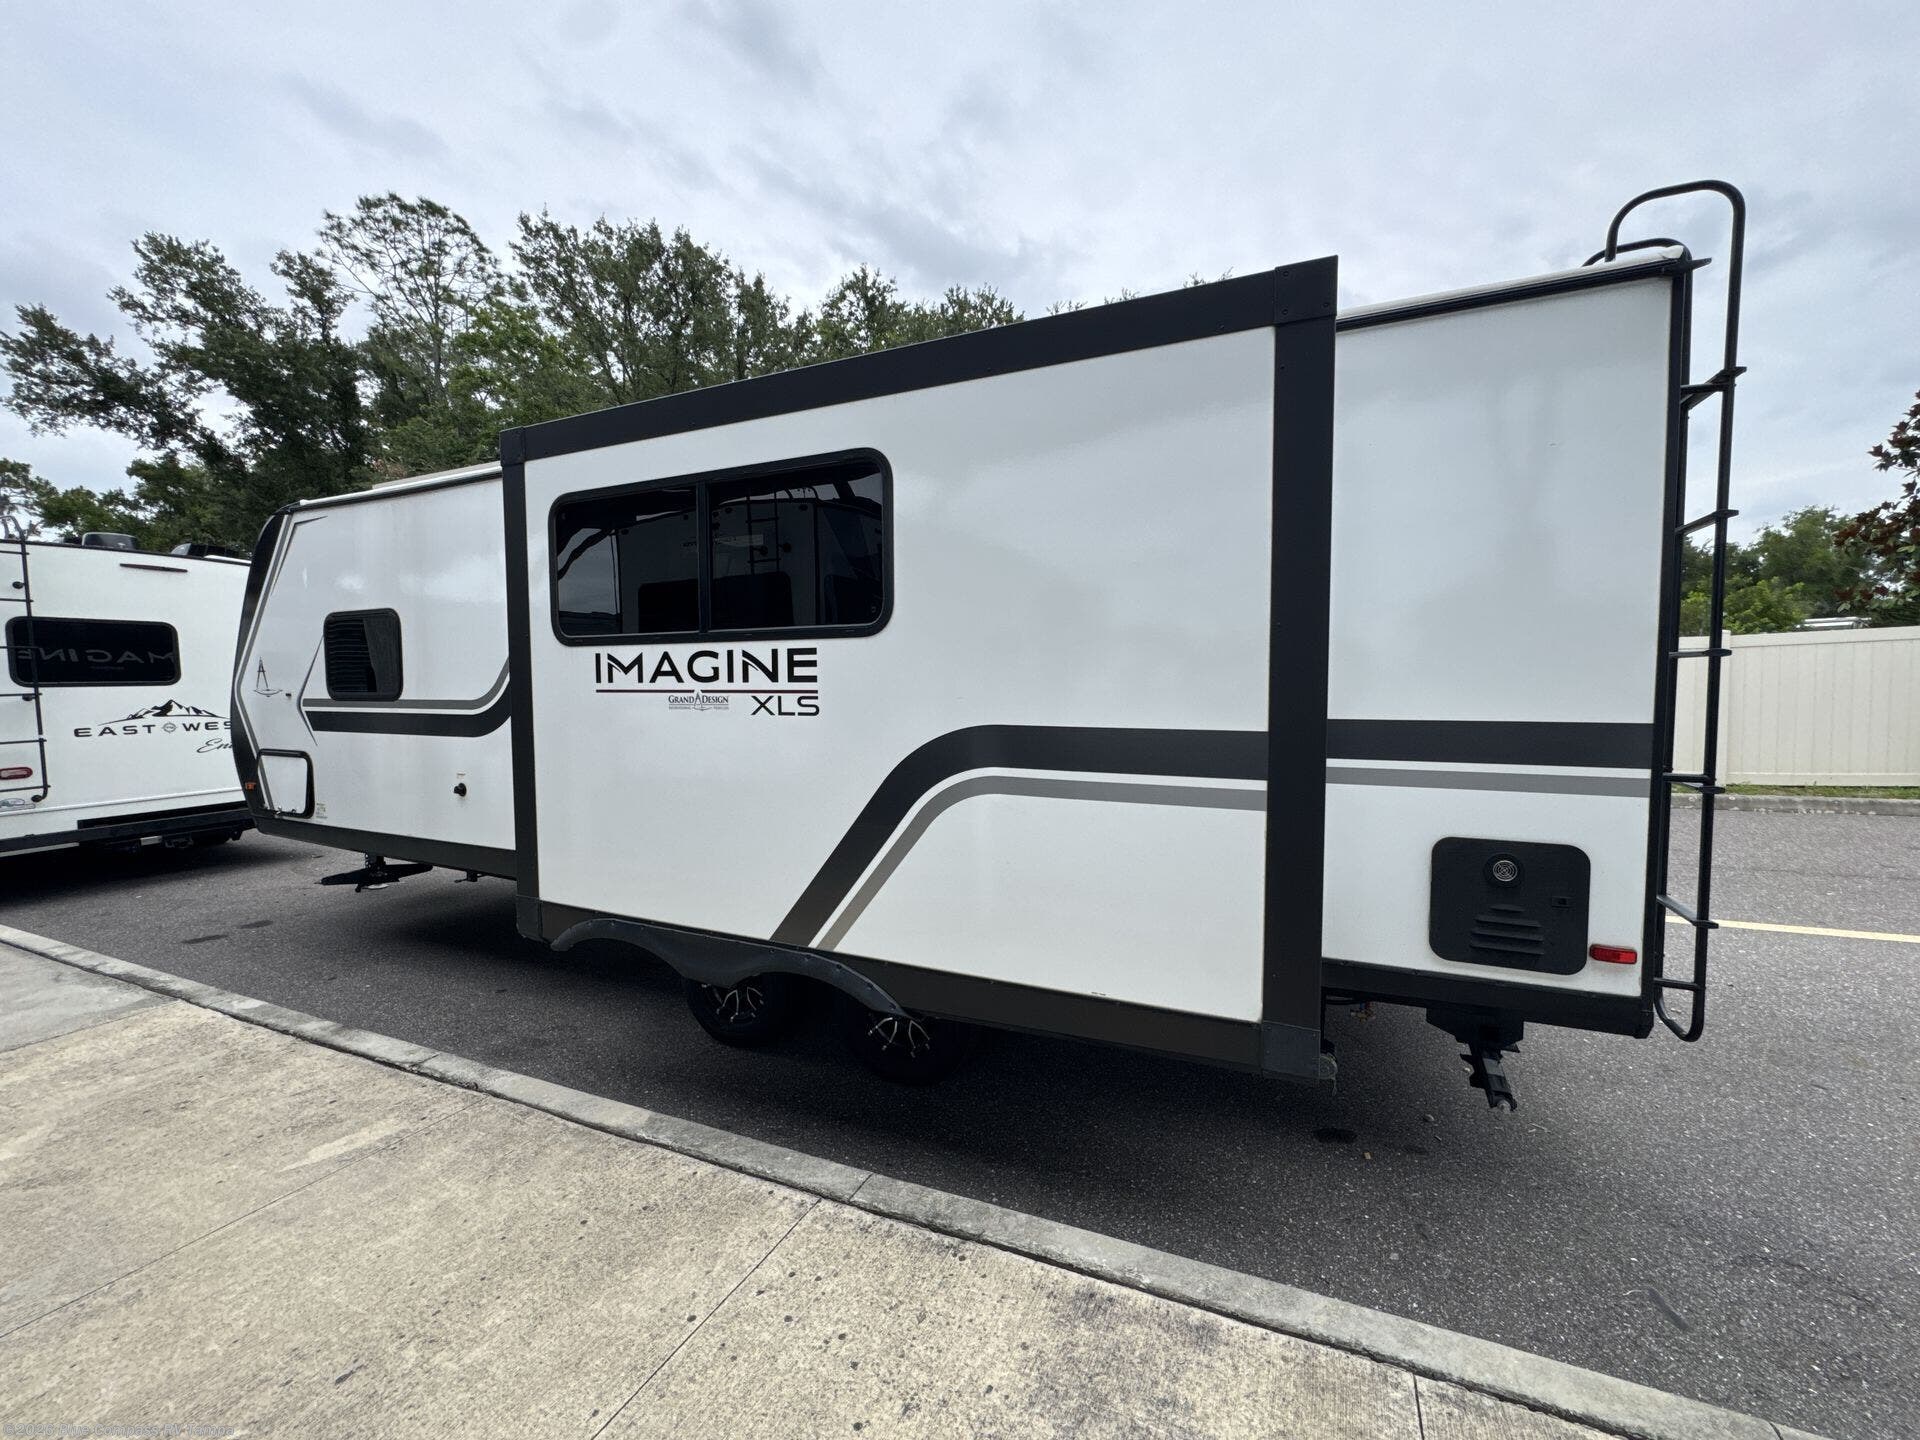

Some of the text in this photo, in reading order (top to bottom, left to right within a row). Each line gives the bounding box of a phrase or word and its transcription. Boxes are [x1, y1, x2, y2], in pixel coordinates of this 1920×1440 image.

[594, 647, 818, 684] IMAGINE
[668, 694, 729, 704] GRAND DESIGN
[751, 695, 820, 717] XLS
[74, 720, 232, 738] EAST WES
